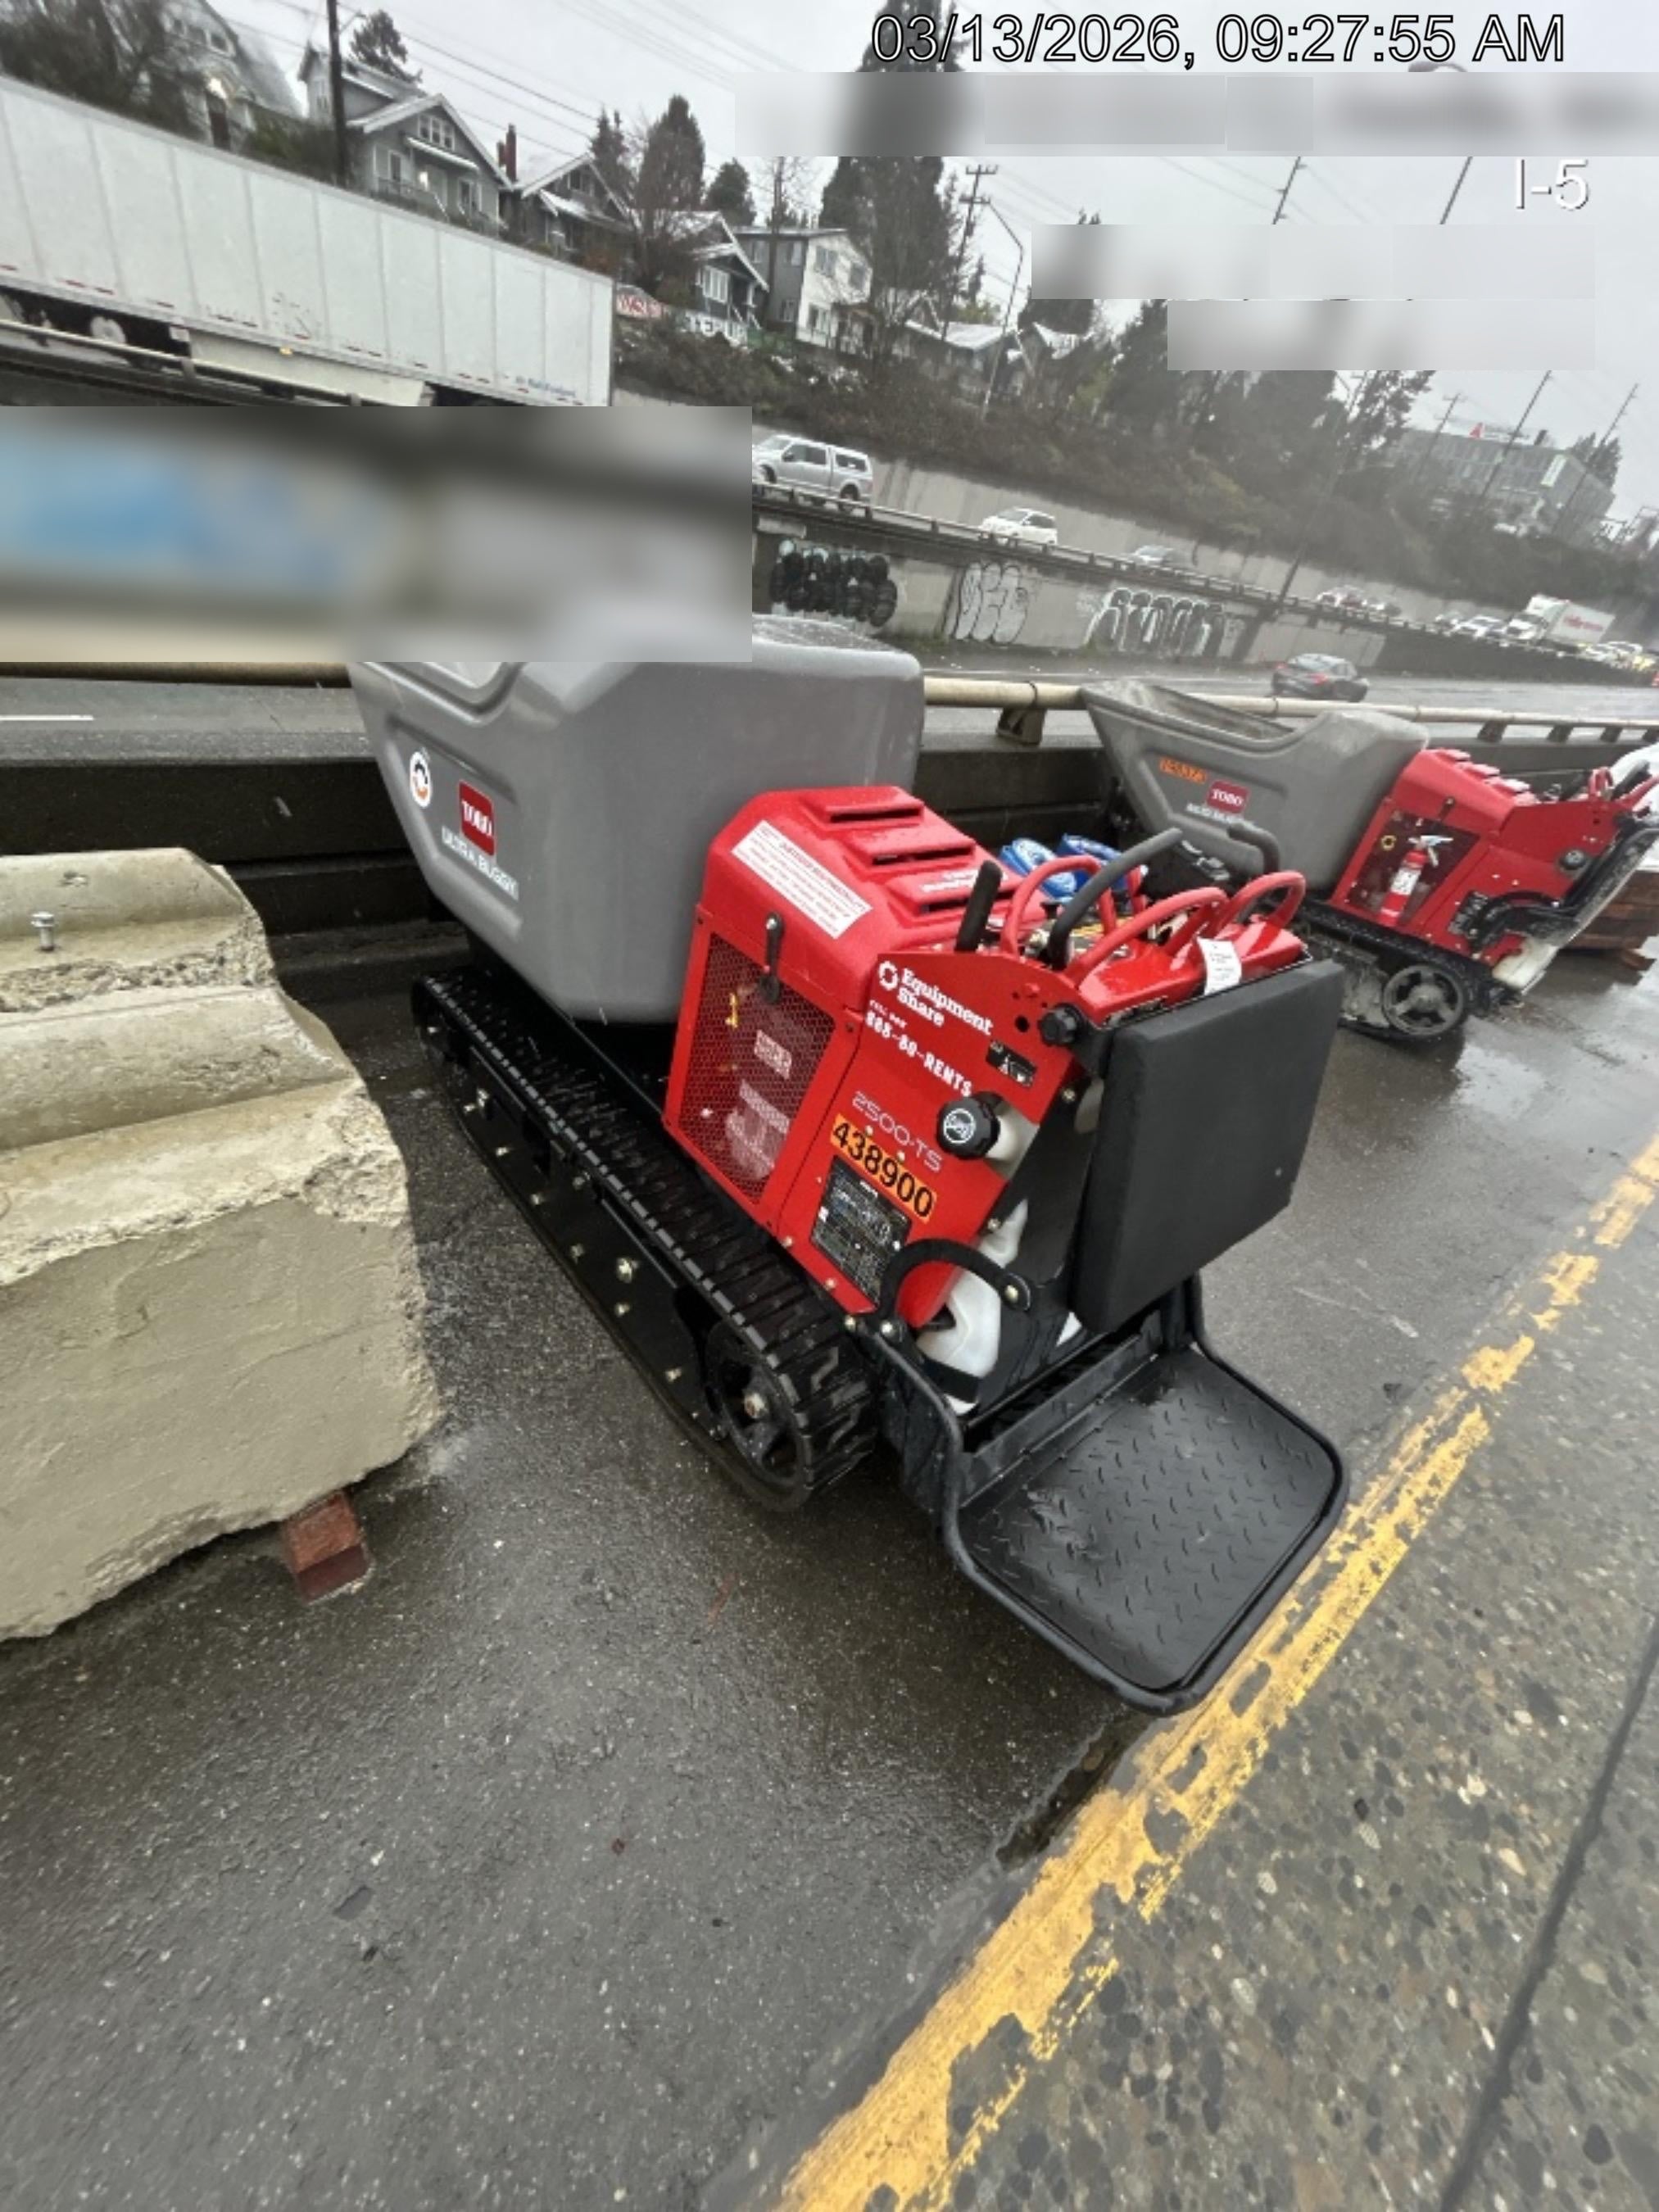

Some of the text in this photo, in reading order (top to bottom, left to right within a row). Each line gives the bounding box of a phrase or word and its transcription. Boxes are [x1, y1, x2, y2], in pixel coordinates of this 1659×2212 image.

[896, 986, 945, 1027] Share
[901, 967, 995, 1036] Equipment
[833, 1122, 933, 1218] 438900
